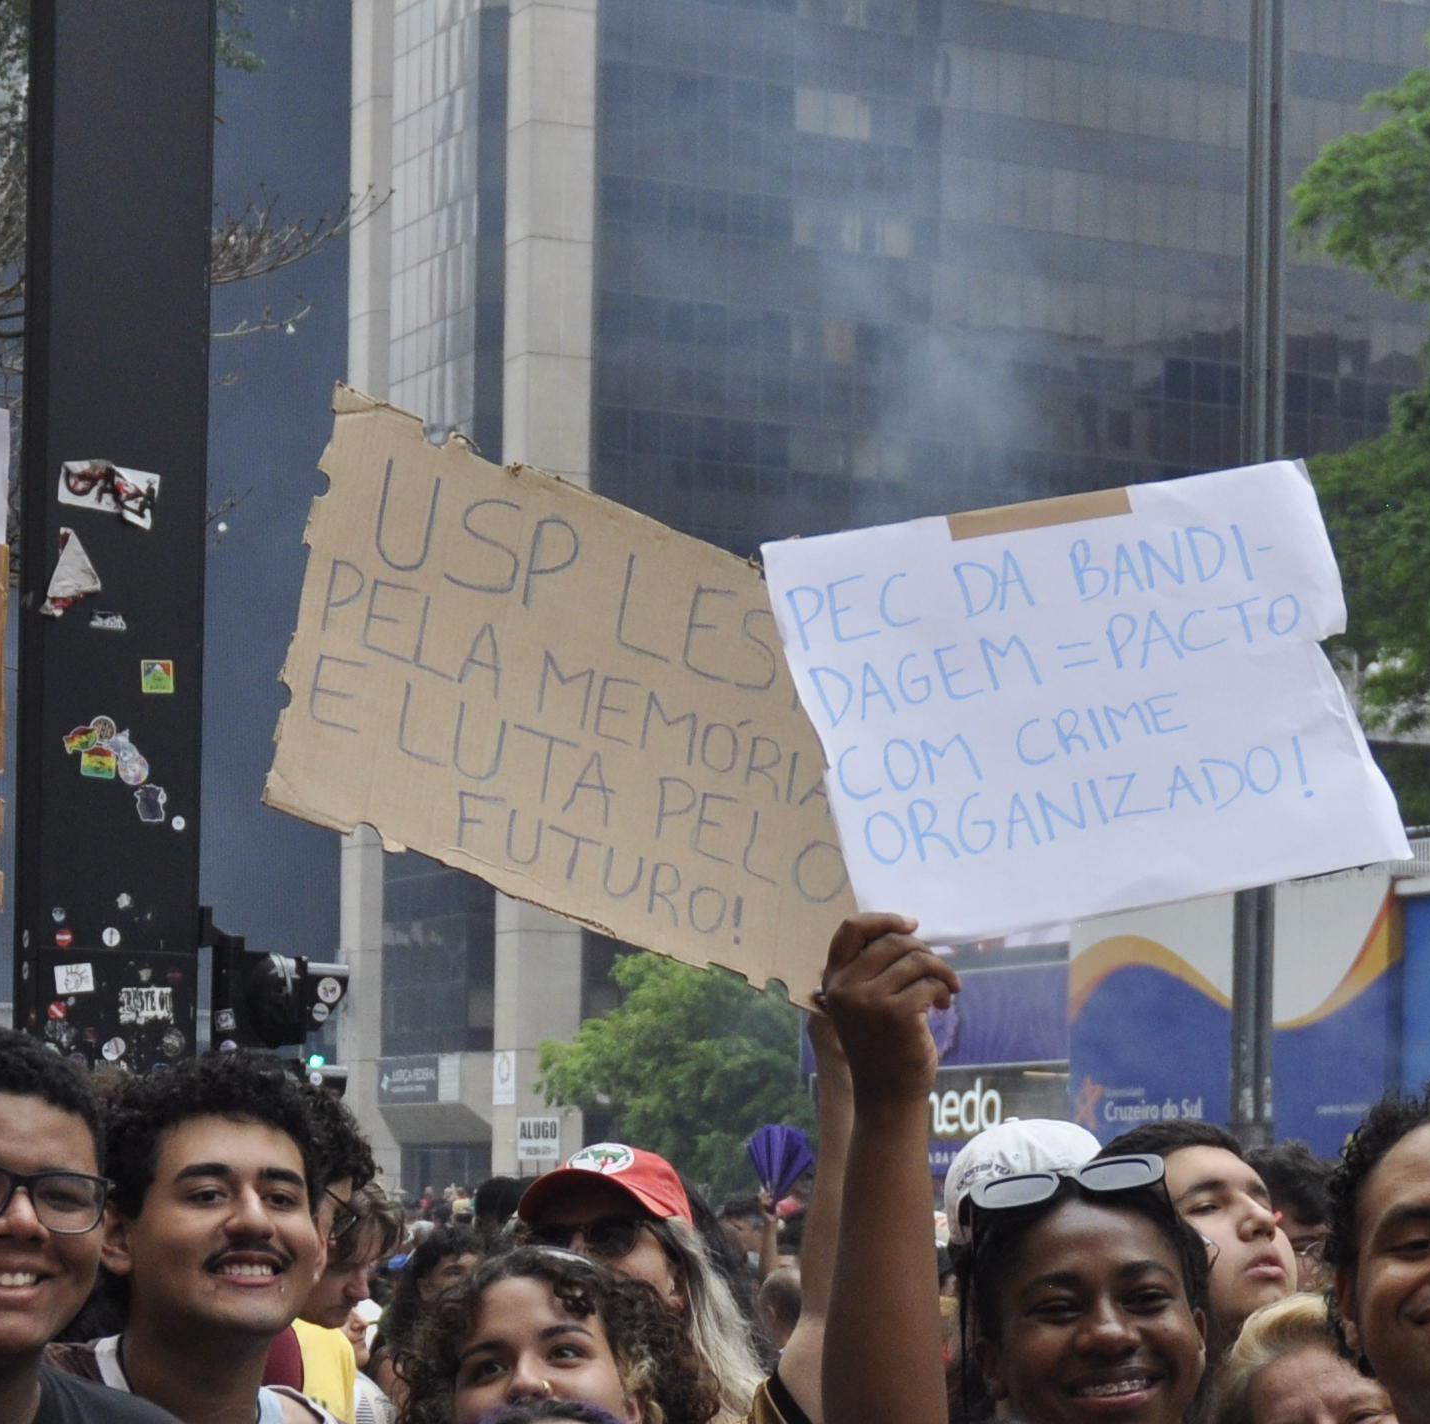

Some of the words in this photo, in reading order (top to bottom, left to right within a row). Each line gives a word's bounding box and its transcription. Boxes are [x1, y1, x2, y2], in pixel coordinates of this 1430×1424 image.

[319, 556, 502, 699] PELA
[373, 456, 579, 607] USP
[614, 552, 797, 711] LES
[785, 573, 921, 652] PEC
[952, 549, 1036, 619] DA
[1069, 523, 1275, 601] BANDI-
[308, 653, 367, 734] E
[397, 680, 616, 827] LUTA
[653, 775, 850, 903] PELO
[835, 732, 985, 801] COM
[1015, 692, 1189, 768] CRIME
[863, 735, 1316, 866] ORGANIZADO!
[455, 789, 744, 946] FUTURO!
[519, 1120, 558, 1140] ALUGO
[1103, 1099, 1159, 1122] Cruzeiro
[1162, 1097, 1179, 1120] do
[1181, 1096, 1203, 1120] Sul
